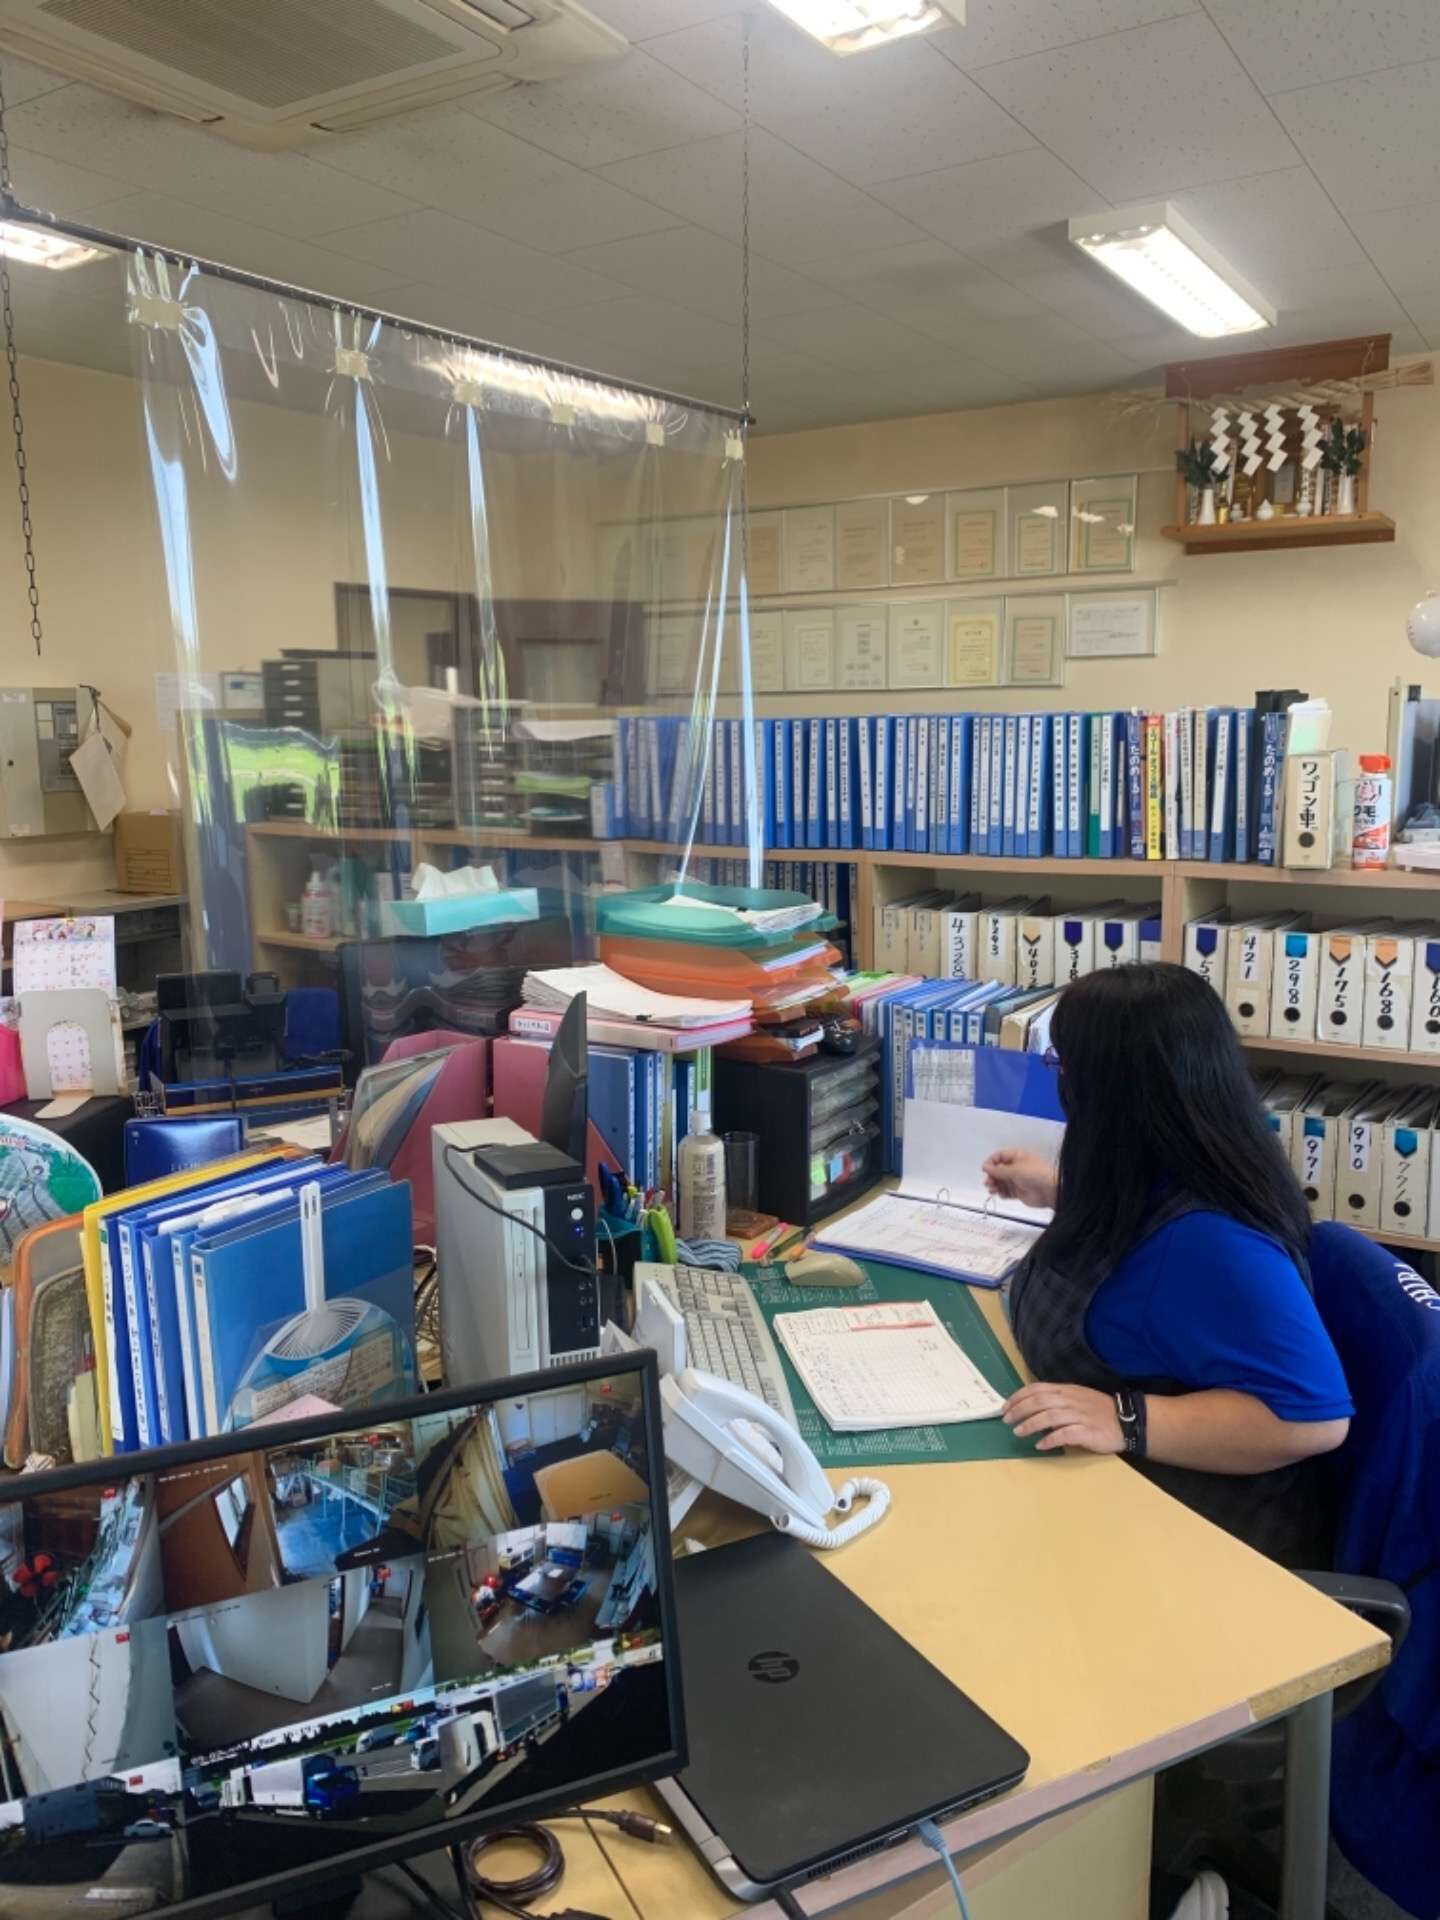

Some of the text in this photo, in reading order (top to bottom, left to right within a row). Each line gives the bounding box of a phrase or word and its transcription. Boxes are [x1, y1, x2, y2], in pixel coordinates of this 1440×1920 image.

[1299, 761, 1320, 828] ワゴン車
[1243, 935, 1257, 980] 421
[1287, 959, 1301, 1004] 298
[1334, 967, 1349, 1009] 175
[1379, 970, 1394, 1015] 168
[1306, 1138, 1320, 1181] 971
[1351, 1126, 1365, 1170] 970
[1394, 1161, 1411, 1201] 771
